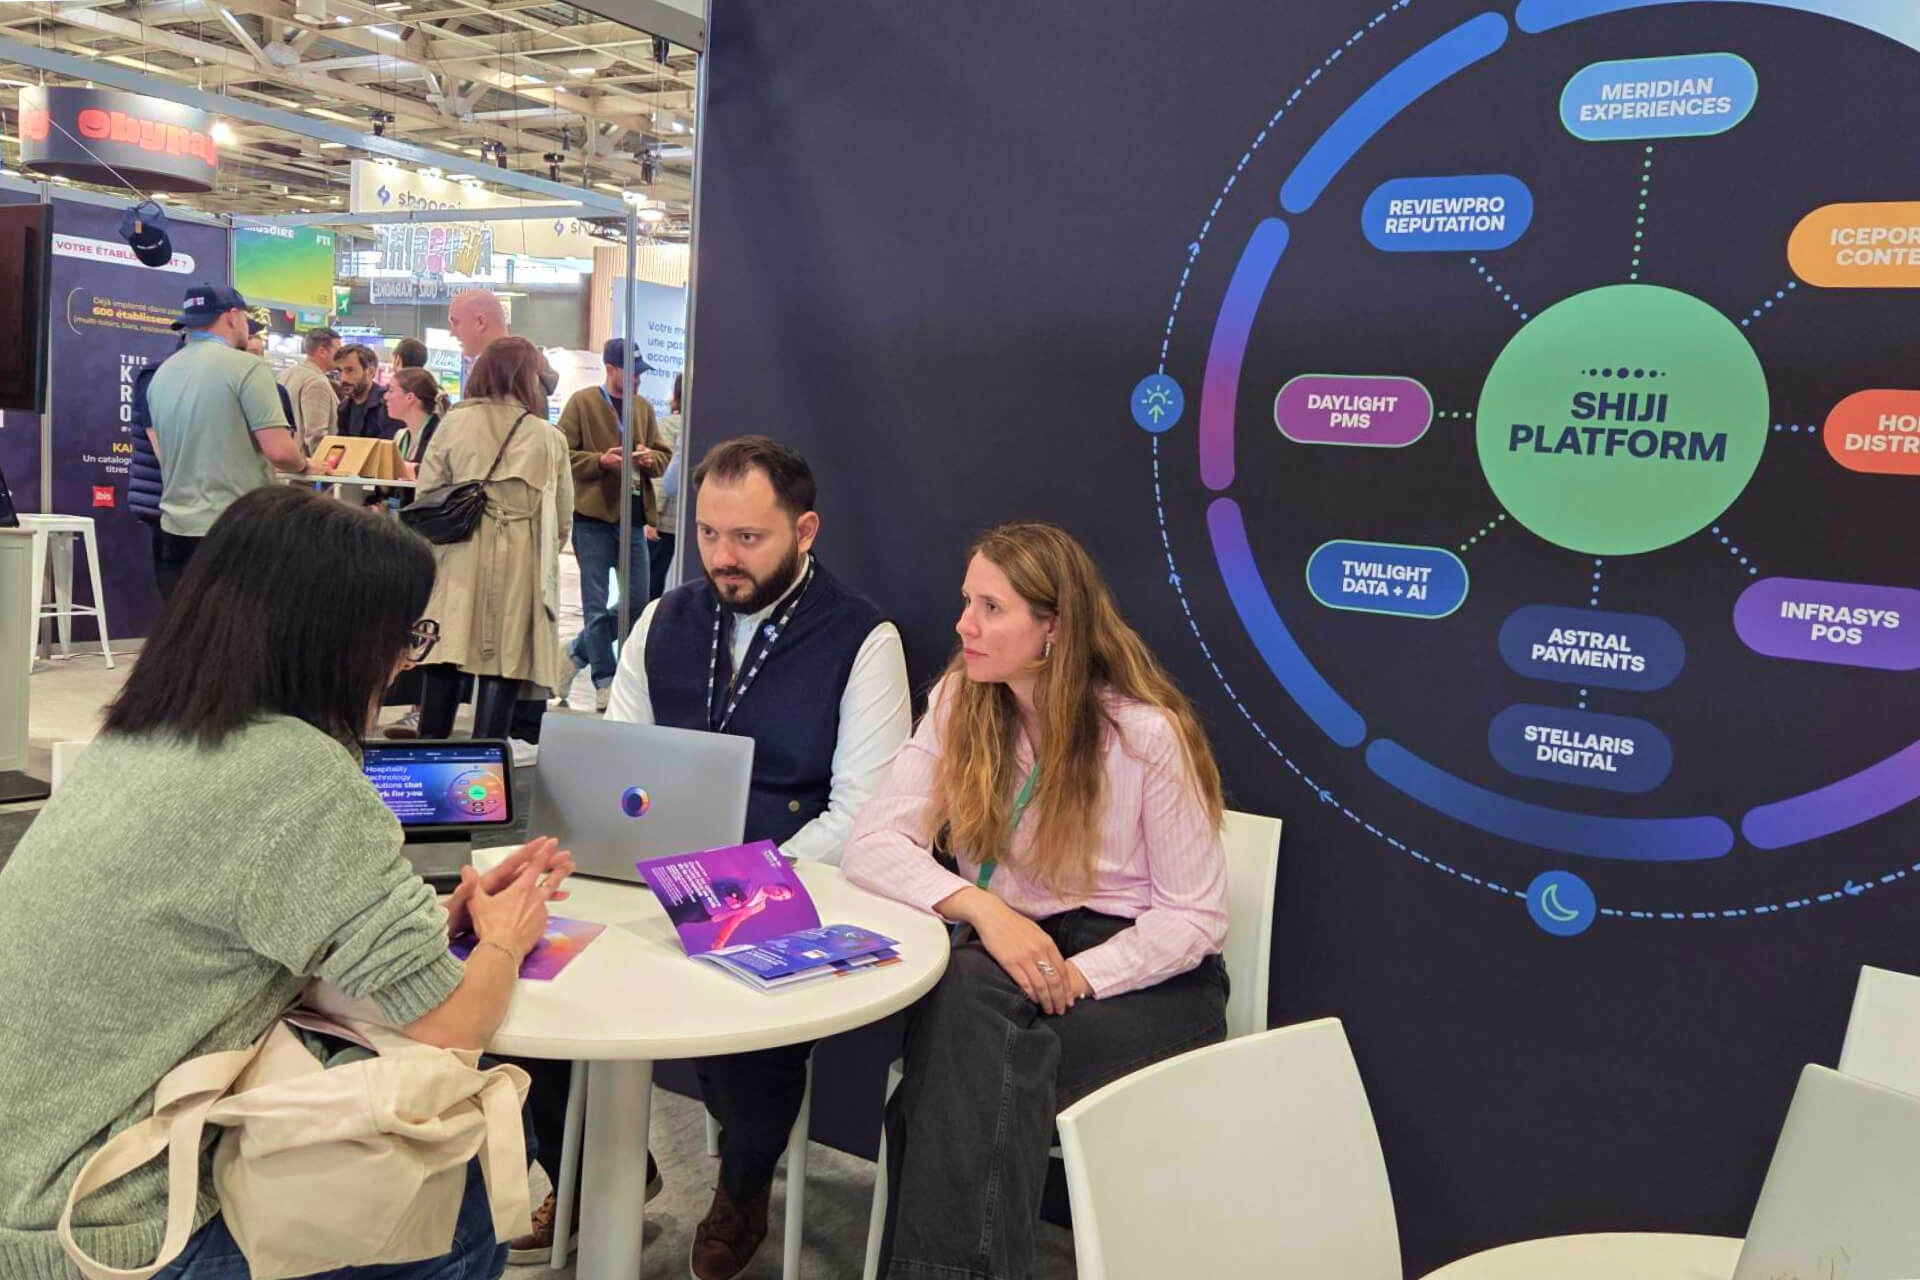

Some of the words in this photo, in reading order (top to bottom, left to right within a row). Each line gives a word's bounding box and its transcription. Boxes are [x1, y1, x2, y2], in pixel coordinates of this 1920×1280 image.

[1601, 77, 1713, 101] MERIDIAN
[1580, 96, 1731, 121] EXPERIENCES
[1389, 196, 1505, 216] REVIEWPRO
[1385, 214, 1505, 234] REPUTATION
[55, 240, 93, 254] VOTRE
[1836, 247, 1920, 266] CONTE
[92, 306, 114, 317] 600
[648, 320, 673, 334] Votre
[120, 354, 148, 366] THIS
[1307, 394, 1398, 412] DAYLIGHT
[1570, 391, 1668, 423] SHIJI
[1329, 411, 1371, 429] PMS
[1878, 414, 1920, 433] HO
[1509, 424, 1728, 462] PLATFORM
[1845, 432, 1920, 453] DISTR
[82, 454, 96, 463] Un
[1342, 560, 1432, 583] TWILIGHT
[1342, 577, 1390, 597] DATA
[1393, 586, 1404, 597] +
[1406, 583, 1428, 600] AI
[1780, 601, 1900, 630] INFRASYS
[1546, 628, 1631, 653] ASTRAL
[1810, 622, 1863, 645] POS
[1531, 644, 1645, 672] PAYMENTS
[1524, 725, 1635, 756] STELLARIS
[1536, 744, 1618, 772] DIGITAL
